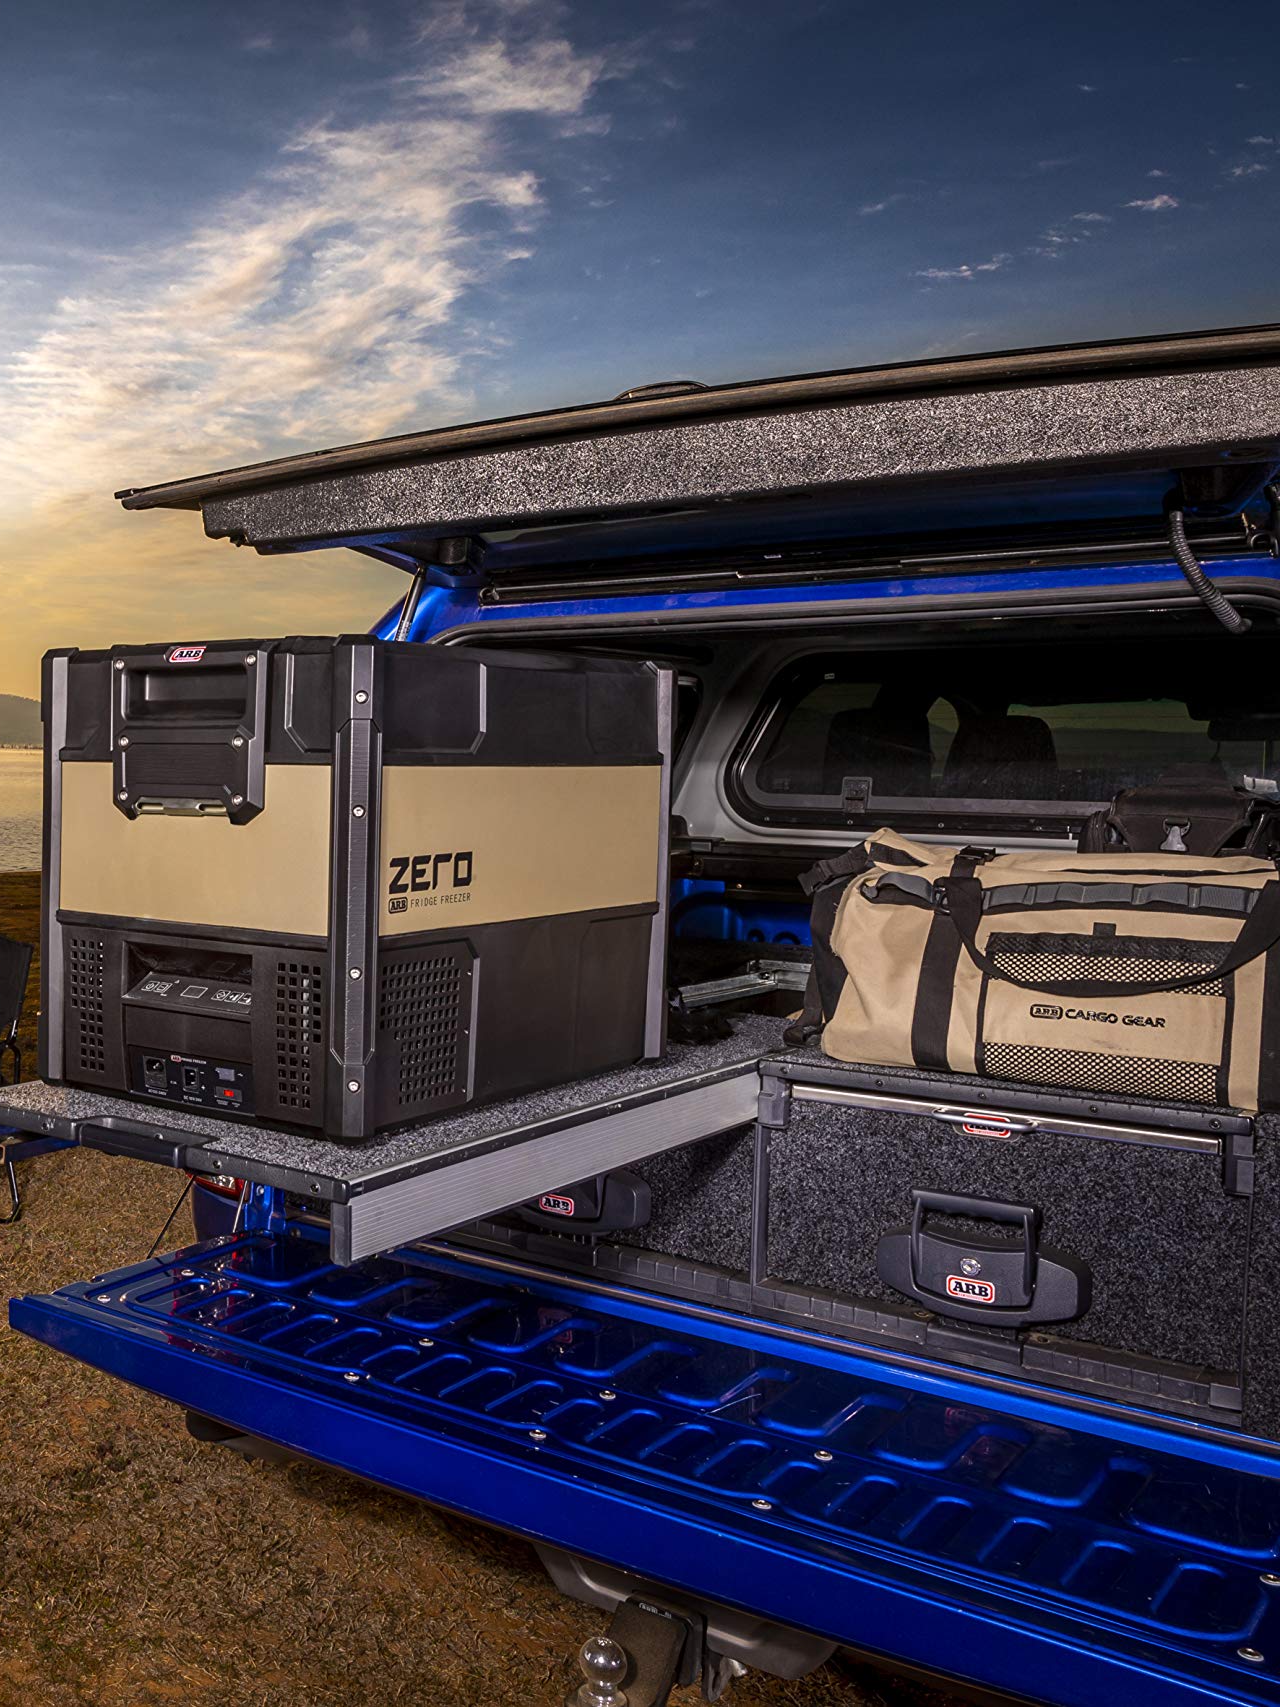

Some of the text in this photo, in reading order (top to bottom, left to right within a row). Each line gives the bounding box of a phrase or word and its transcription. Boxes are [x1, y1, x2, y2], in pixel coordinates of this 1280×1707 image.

[410, 896, 437, 908] FRIDGE
[440, 892, 471, 904] FREEZER
[1065, 1009, 1118, 1024] CARGO
[1122, 1015, 1166, 1028] GEAR
[543, 1197, 570, 1211] ARB
[953, 1281, 989, 1297] ARB
